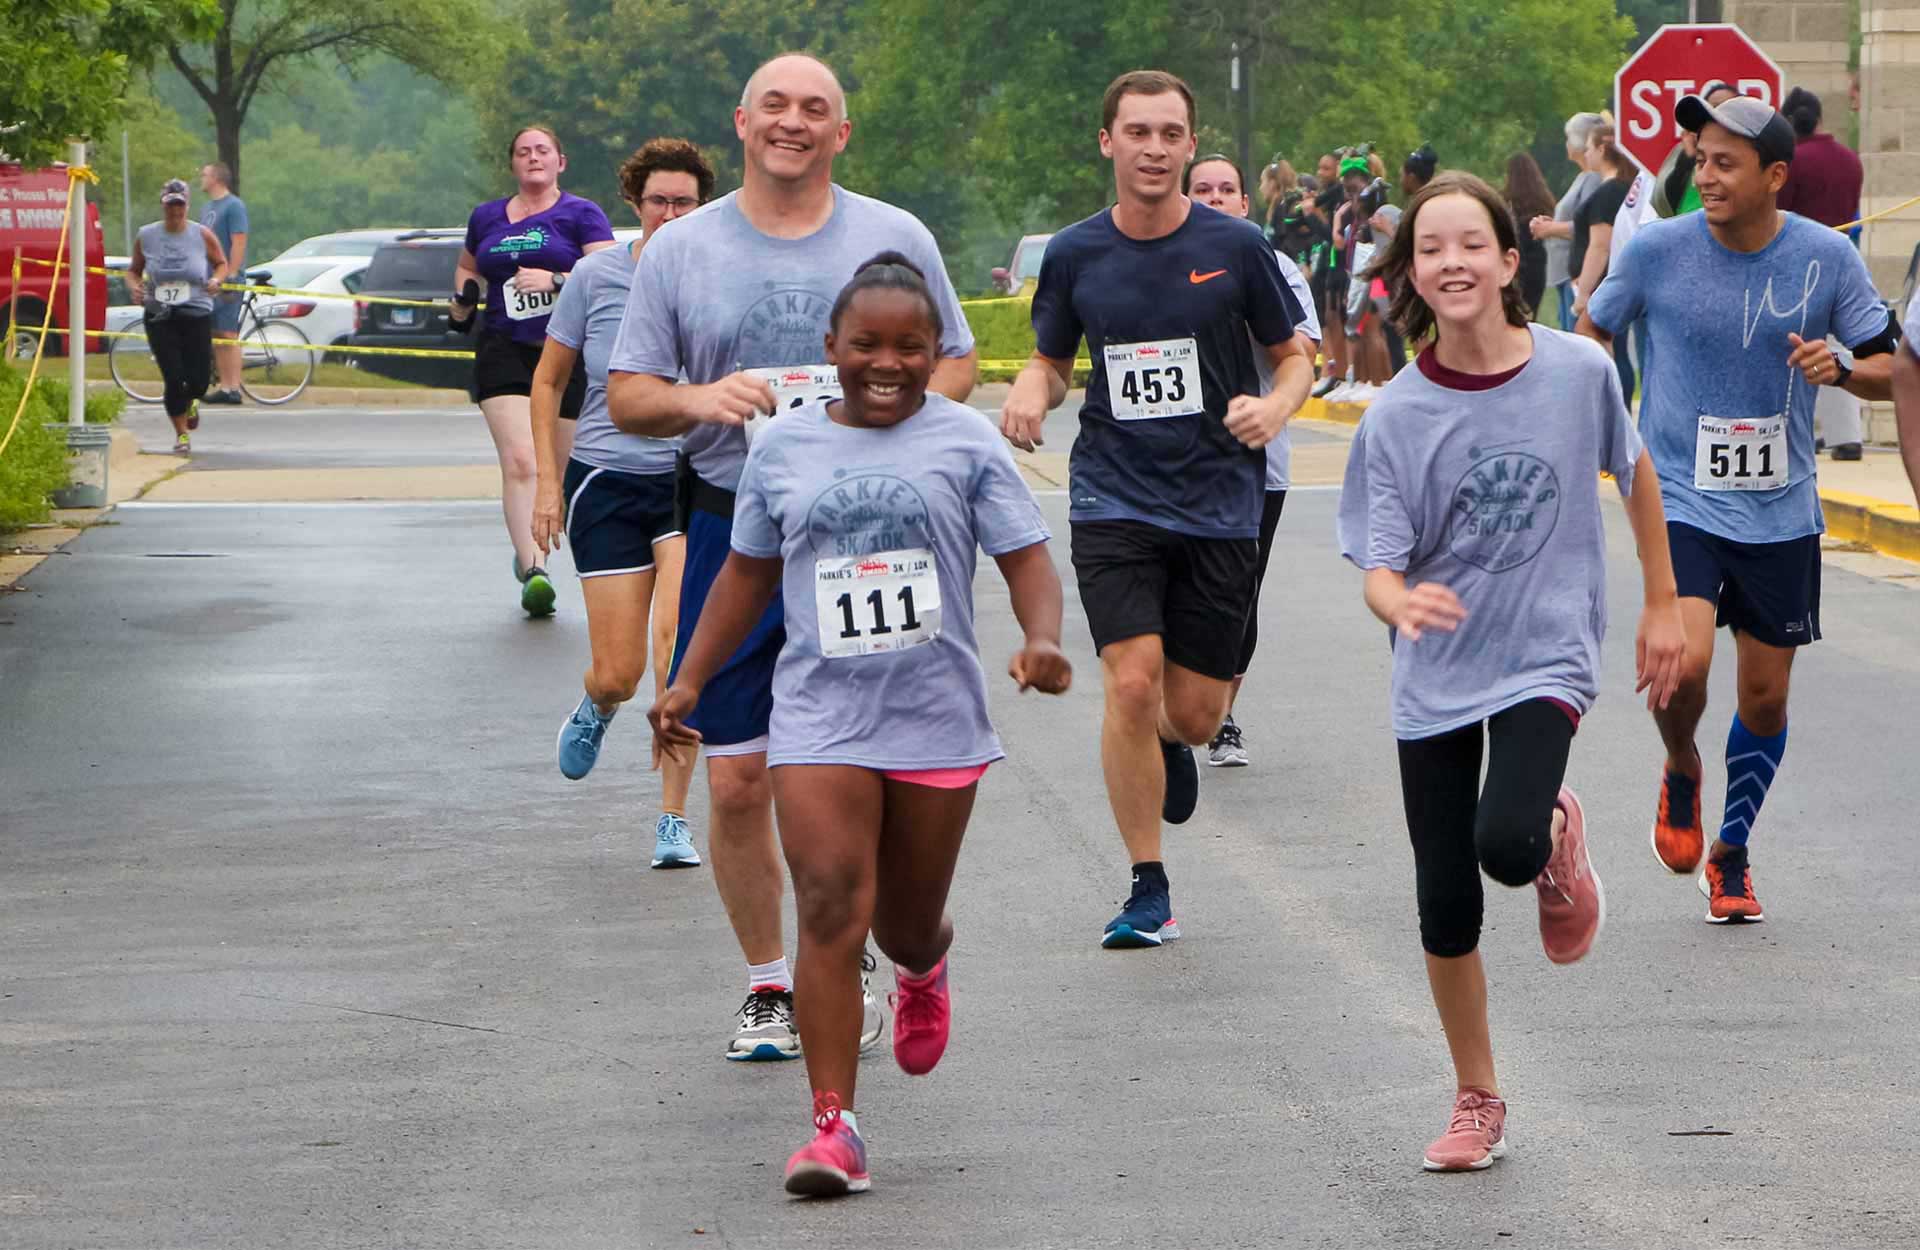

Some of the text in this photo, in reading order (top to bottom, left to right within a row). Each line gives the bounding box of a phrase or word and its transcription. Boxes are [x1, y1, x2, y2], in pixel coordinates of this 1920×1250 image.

[1629, 79, 1771, 138] STP
[16, 208, 67, 229] DIVISIO
[164, 288, 180, 301] 37
[514, 289, 553, 312] 360
[743, 294, 828, 342] PARKIE
[1122, 366, 1186, 405] 453
[1710, 443, 1774, 478] 511
[819, 568, 852, 581] PARKIE'S
[893, 563, 904, 573] 5K
[914, 560, 928, 571] 10K
[836, 585, 921, 638] 111
